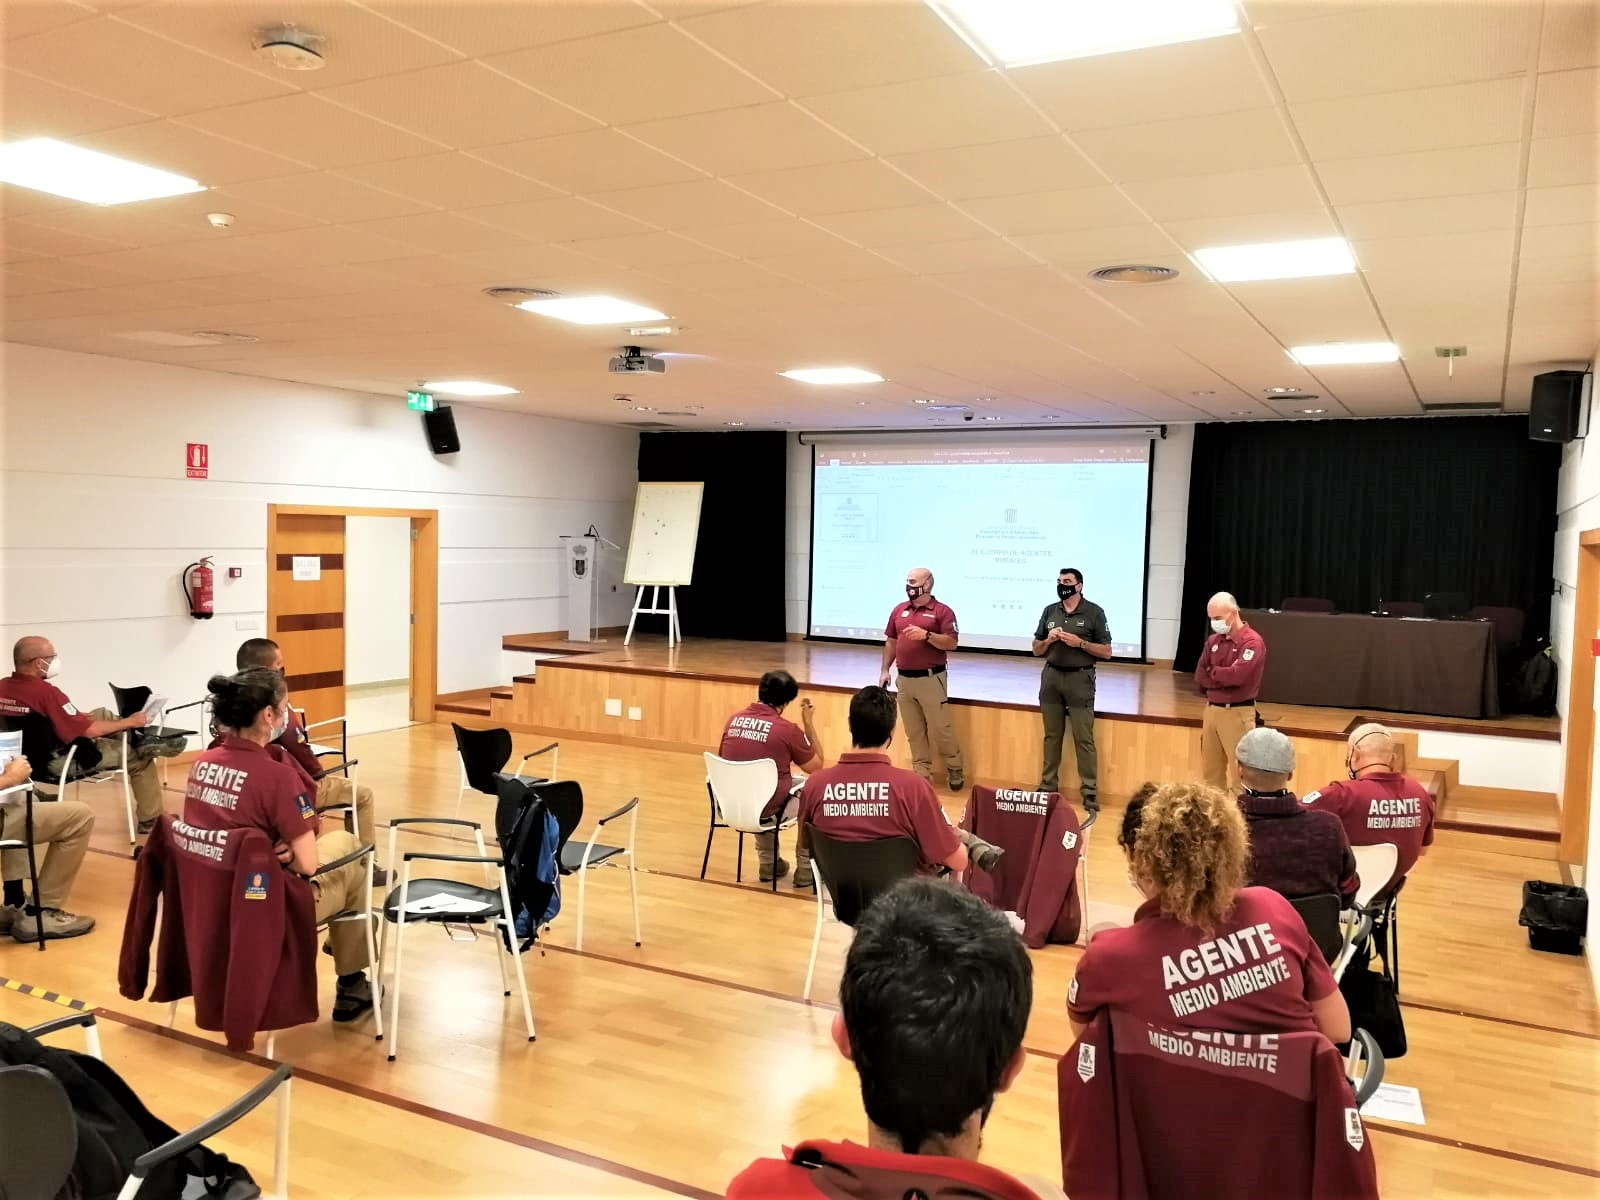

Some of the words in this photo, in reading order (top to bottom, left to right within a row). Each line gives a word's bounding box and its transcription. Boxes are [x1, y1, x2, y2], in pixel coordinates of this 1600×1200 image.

[729, 716, 774, 732] AGENTE
[728, 728, 740, 737] MEDIO
[741, 730, 769, 742] AMBIENTE
[191, 760, 248, 792] AGENTE
[200, 787, 239, 811] AMBIENTE
[823, 782, 890, 800] AGENTE
[995, 788, 1049, 805] AGENTE
[823, 803, 848, 817] MEDIO
[850, 803, 889, 817] AMBIENTE
[996, 802, 1014, 812] MEDIO
[1015, 803, 1047, 816] AMBIENTE
[1368, 798, 1421, 815] AGENTE
[1367, 817, 1390, 829] MEDIO
[1391, 816, 1421, 828] AMBIENTE
[188, 840, 224, 862] AMBIENTE
[1161, 923, 1282, 991] AGENTE
[1168, 983, 1219, 1018] MEDIO
[1222, 956, 1290, 1002] AMBIENTE
[1148, 1030, 1194, 1056] MEDIO
[1198, 1044, 1278, 1074] AMBIENTE
